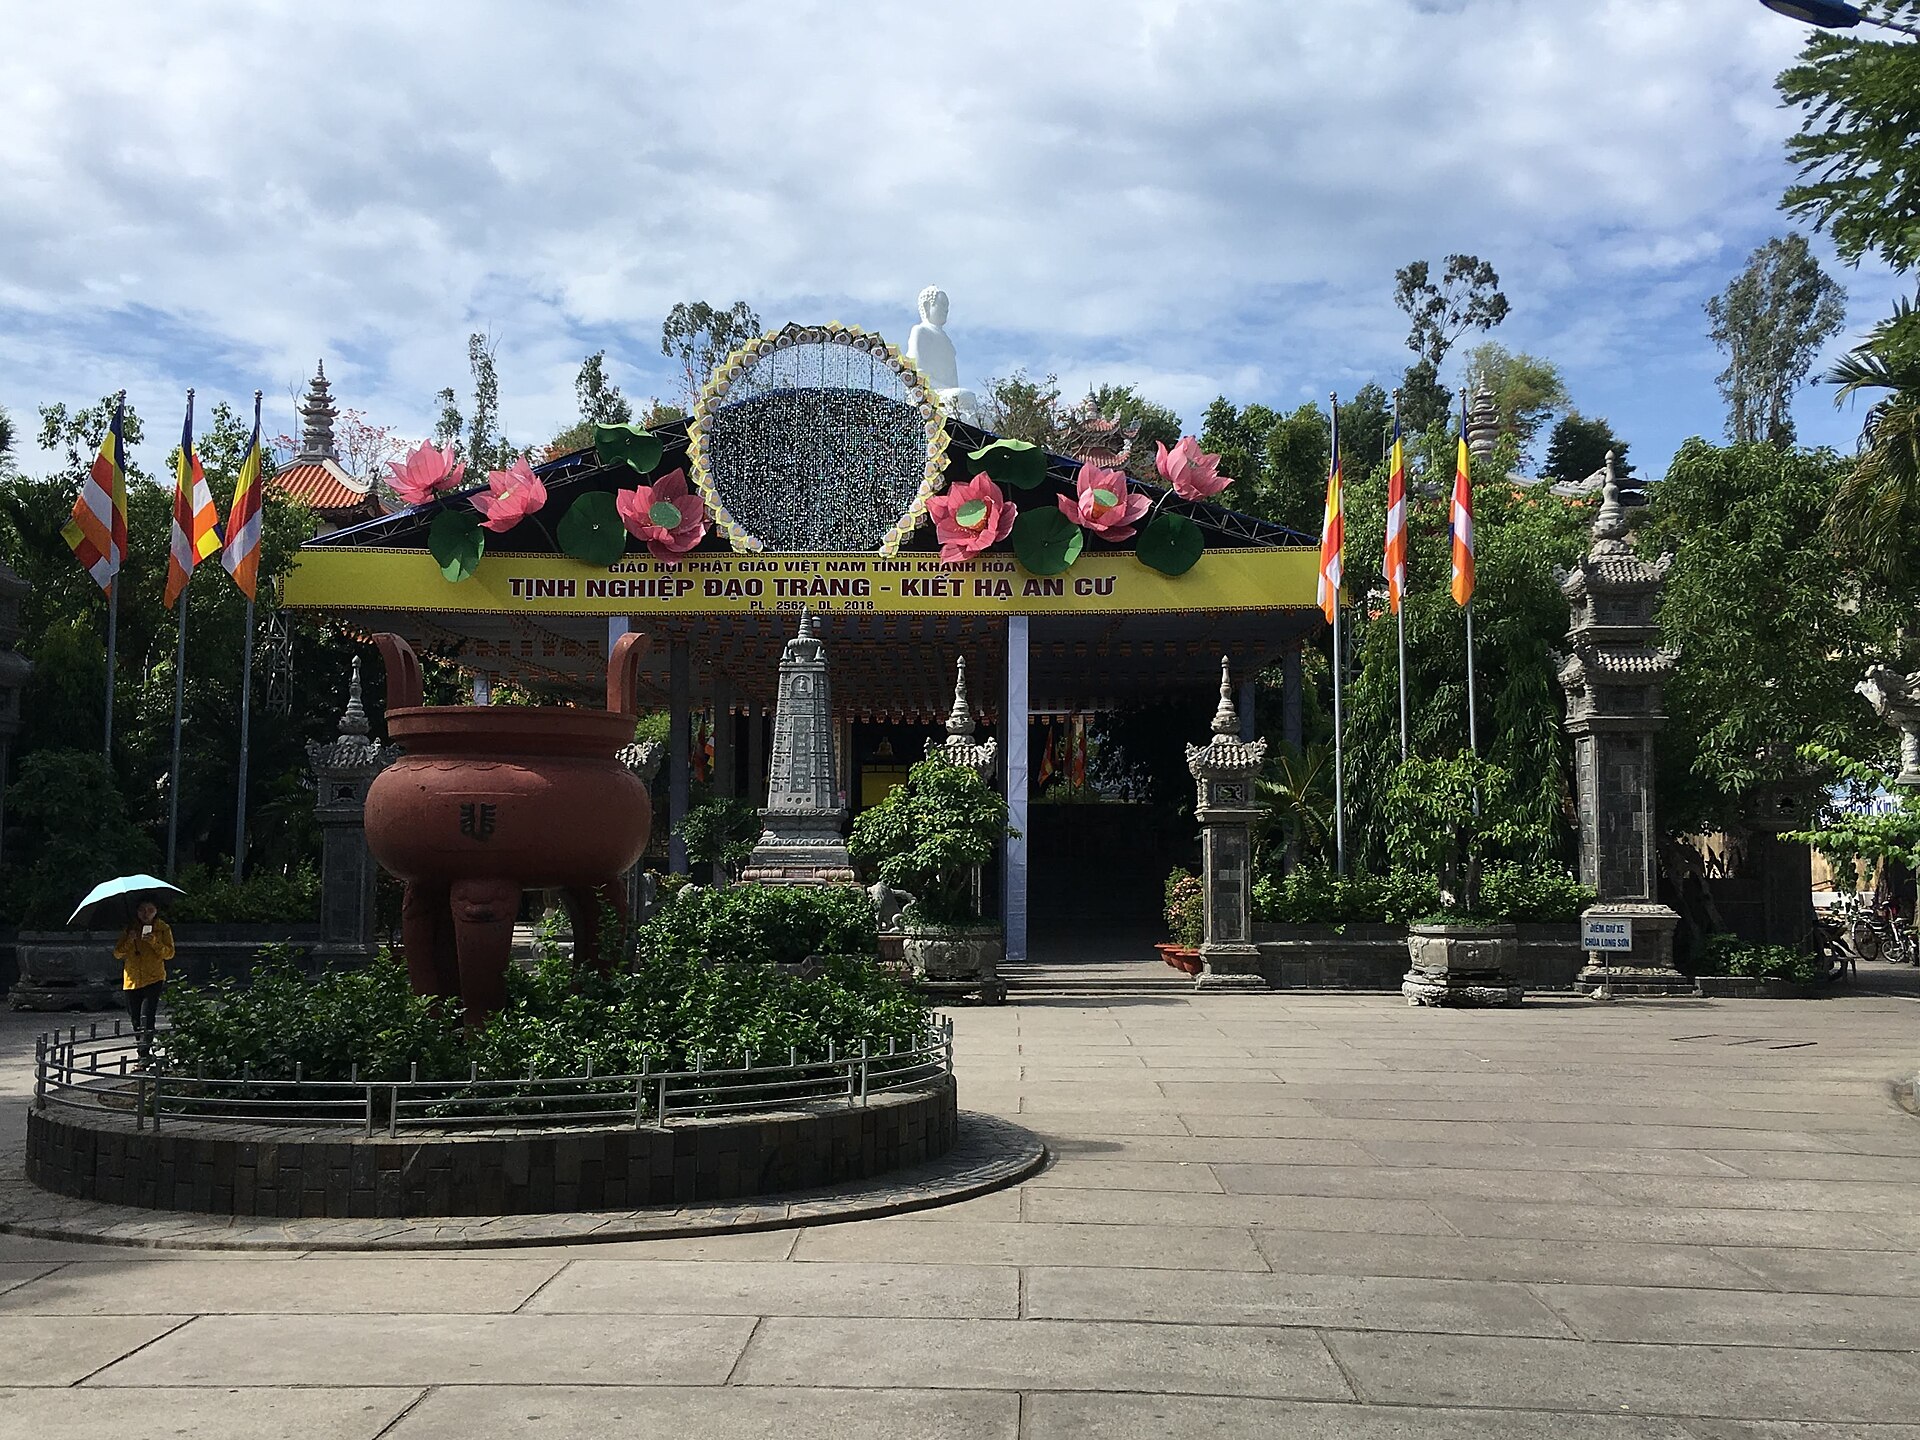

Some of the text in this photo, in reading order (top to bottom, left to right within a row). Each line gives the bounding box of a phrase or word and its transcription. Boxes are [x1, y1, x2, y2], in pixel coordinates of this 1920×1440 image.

[608, 561, 648, 573] GIÁO
[688, 560, 733, 574] PHẬT
[738, 560, 778, 572] GIÁO
[784, 560, 820, 574] VIỆT
[826, 561, 866, 572] NAM
[982, 560, 1016, 572] HÒA
[508, 578, 576, 600] TỊNH
[586, 575, 695, 601] NGHIỆP
[703, 578, 763, 600] ĐẠO
[772, 574, 870, 597] TRÀNG
[901, 573, 965, 597] KIẾT
[974, 578, 1013, 600] HẠ
[1022, 578, 1064, 597] AN
[1074, 575, 1117, 596] CƯ
[776, 601, 806, 610] 2562
[844, 601, 874, 610] 2018
[1601, 938, 1616, 947] LONG
